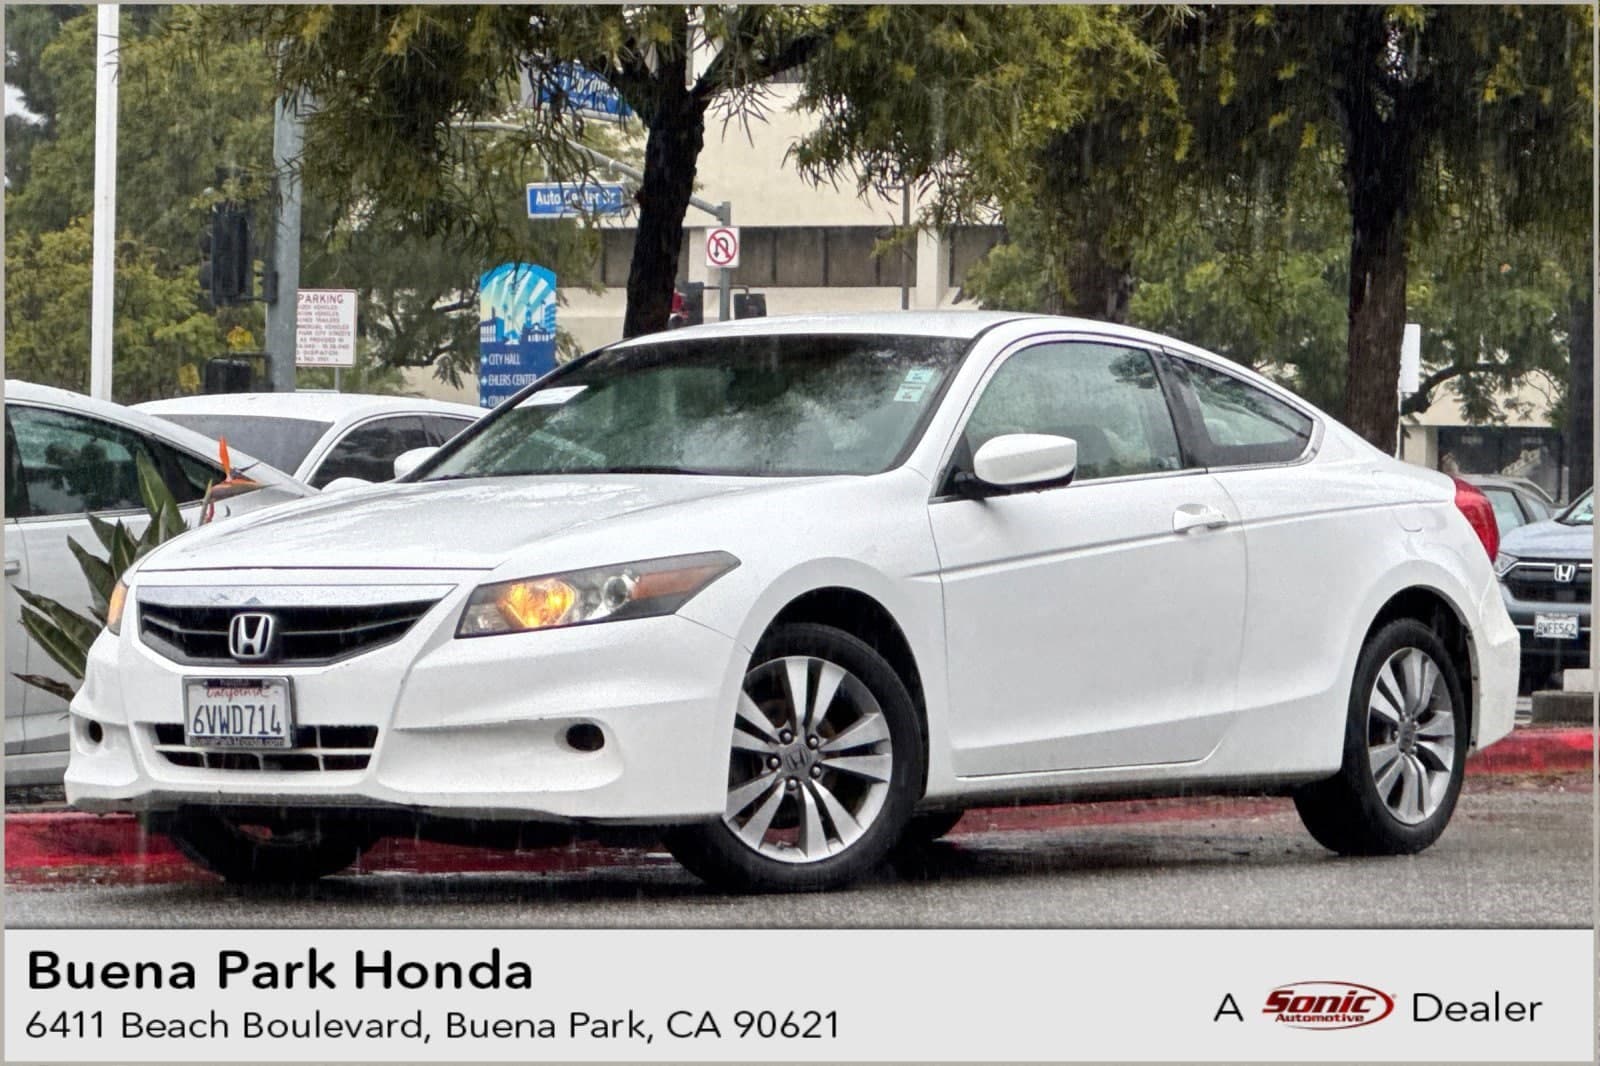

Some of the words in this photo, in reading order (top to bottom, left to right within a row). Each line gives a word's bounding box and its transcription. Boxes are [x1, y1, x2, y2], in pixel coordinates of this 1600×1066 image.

[536, 190, 561, 205] Auto
[297, 294, 344, 304] PARKING
[489, 353, 503, 366] CITY
[504, 353, 520, 366] HALL
[488, 374, 511, 386] EHLERS
[512, 374, 537, 386] CENTER
[193, 704, 281, 735] 6VWD714
